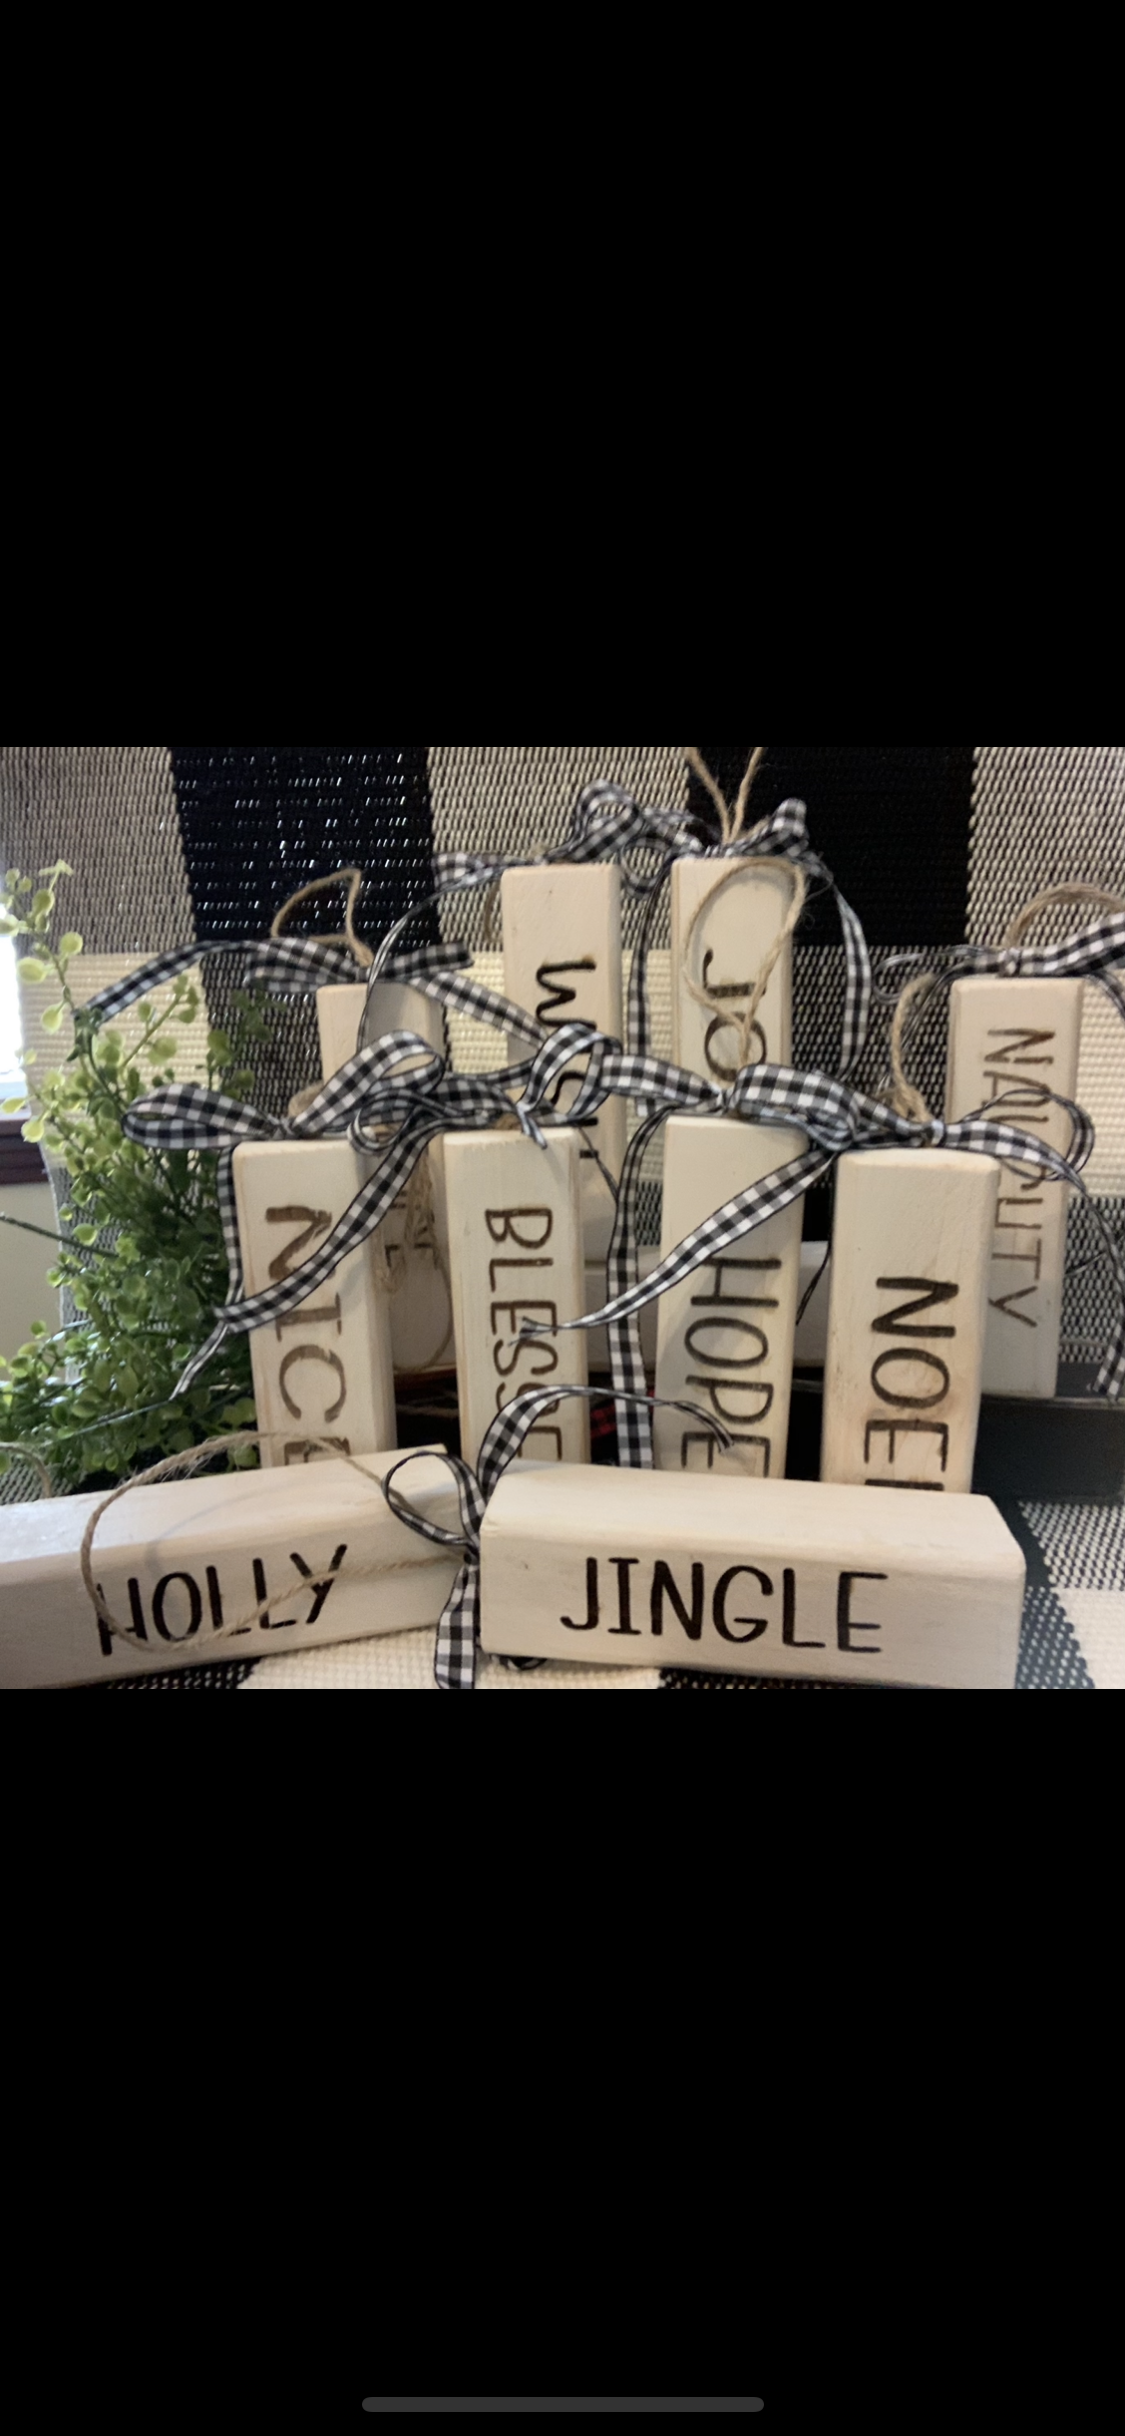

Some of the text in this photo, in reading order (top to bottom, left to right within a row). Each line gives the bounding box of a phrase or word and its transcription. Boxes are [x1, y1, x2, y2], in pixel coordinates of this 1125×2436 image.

[682, 1256, 782, 1478] HOPE
[96, 1544, 348, 1656] HOLLY
[560, 1556, 888, 1653] JINGLE
